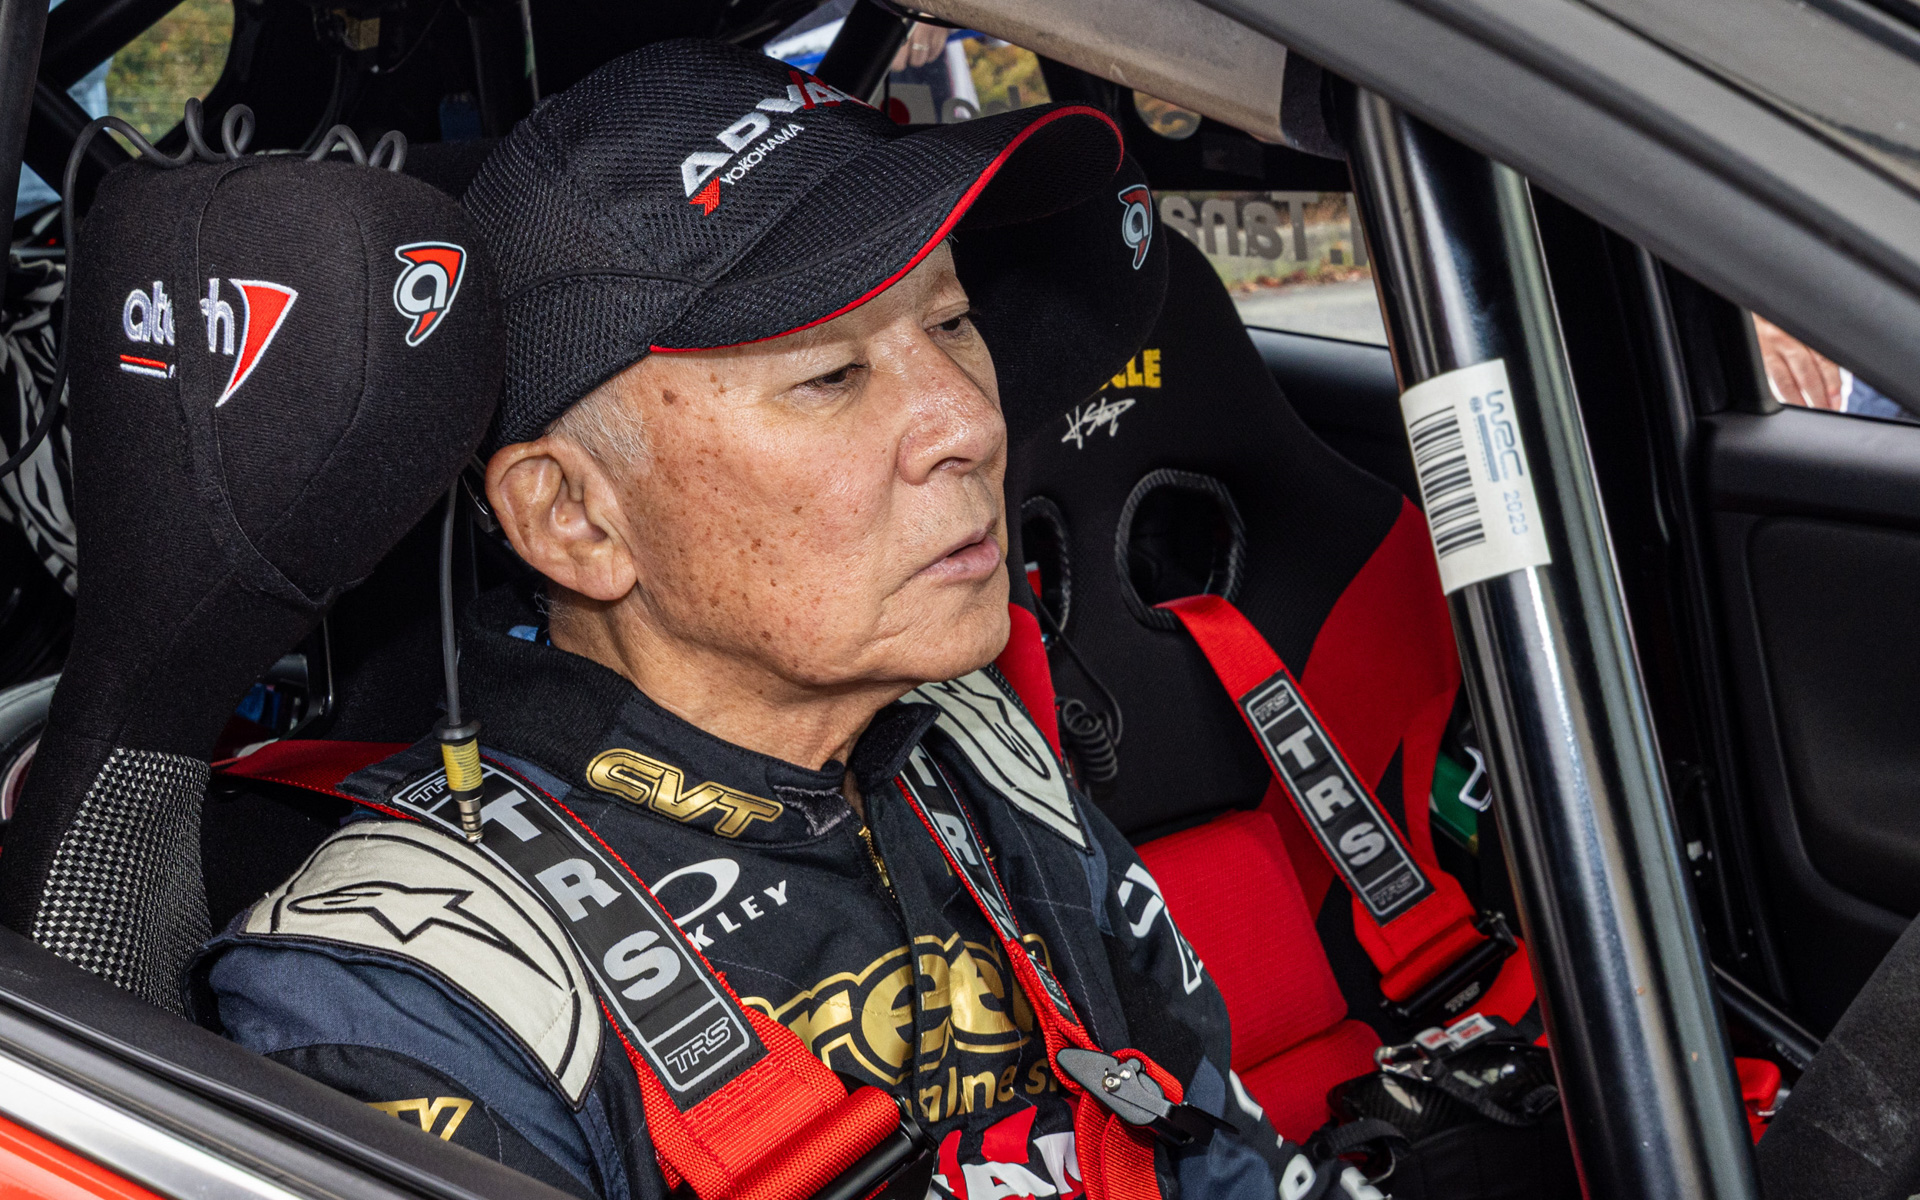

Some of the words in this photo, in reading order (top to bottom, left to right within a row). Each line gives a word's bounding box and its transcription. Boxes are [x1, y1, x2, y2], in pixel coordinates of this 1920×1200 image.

[680, 70, 876, 198] ADVA
[719, 122, 805, 186] YOKOHAMA
[1486, 389, 1524, 477] WRC
[1503, 490, 1529, 536] 2023
[1276, 725, 1386, 866] TRS
[478, 788, 682, 1001] TRS
[664, 1016, 731, 1074] TRS
